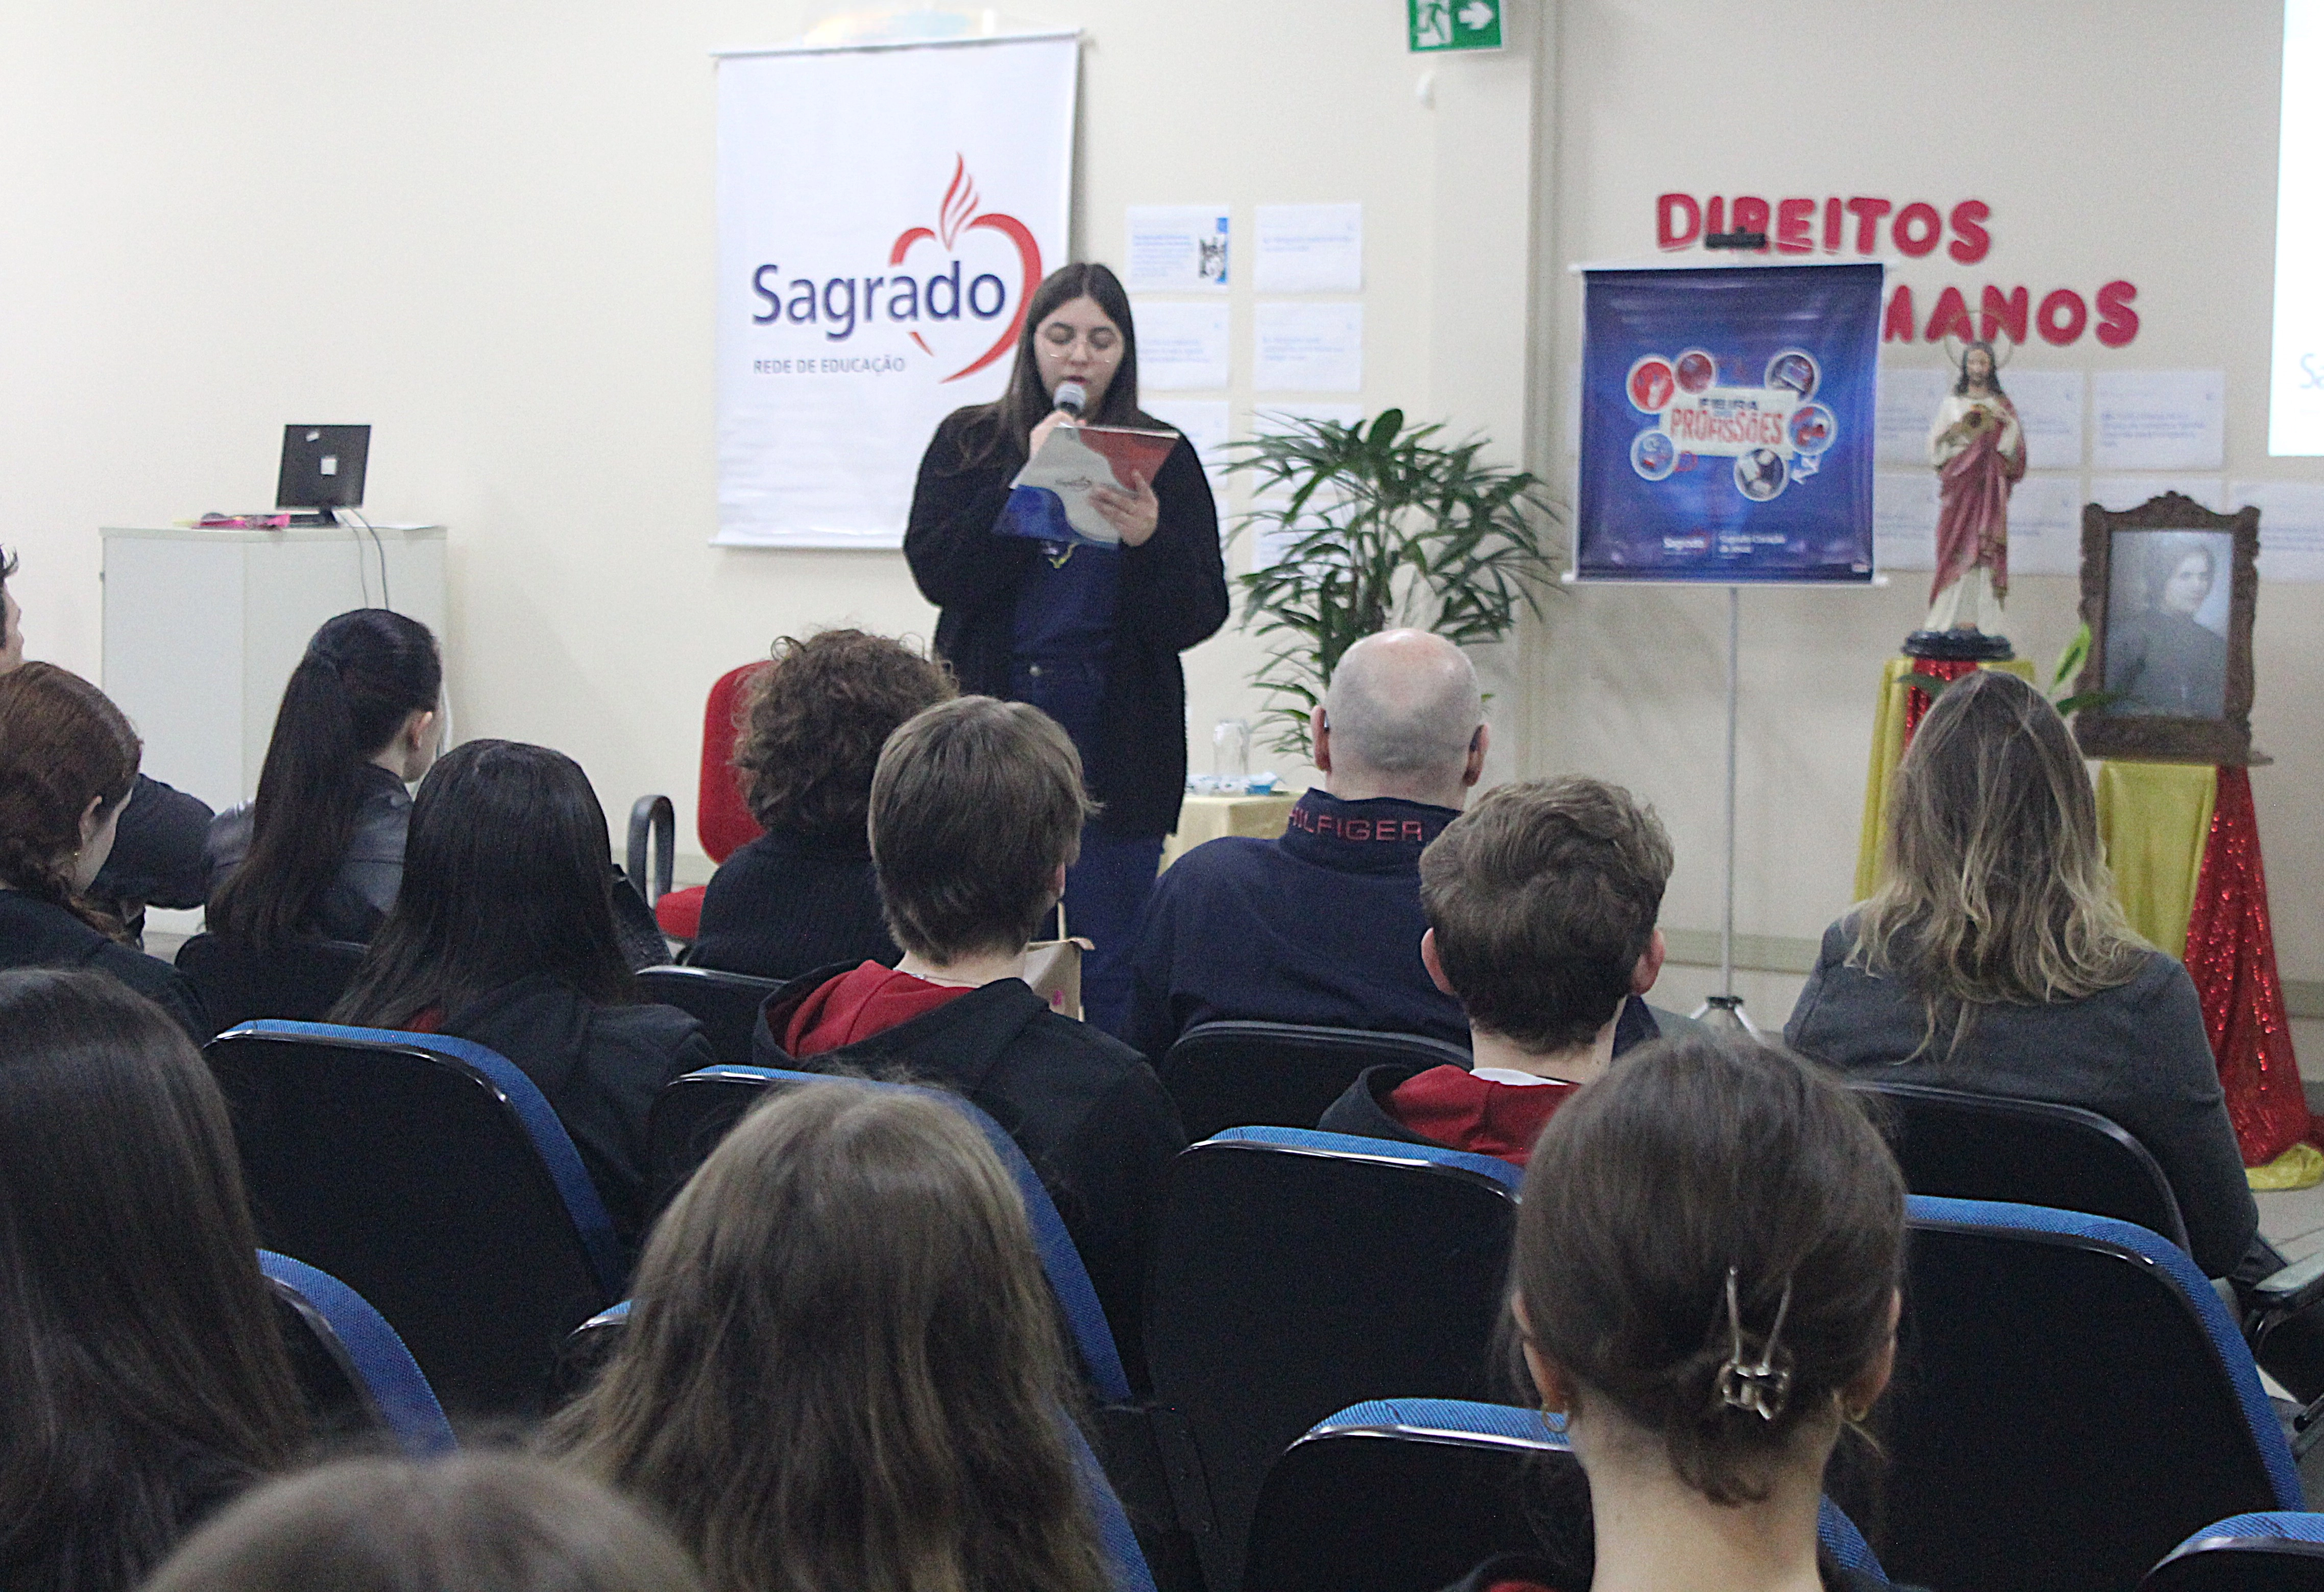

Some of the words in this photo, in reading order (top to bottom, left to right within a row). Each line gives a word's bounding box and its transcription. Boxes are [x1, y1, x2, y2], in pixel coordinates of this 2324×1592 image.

[1656, 193, 1990, 264] DIREITOS
[752, 260, 1006, 341] Sagrado
[754, 359, 791, 374] REDE
[796, 358, 815, 373] DE
[820, 354, 906, 375] EDUCAÇÃO
[1671, 408, 1782, 444] PROFISSÕES
